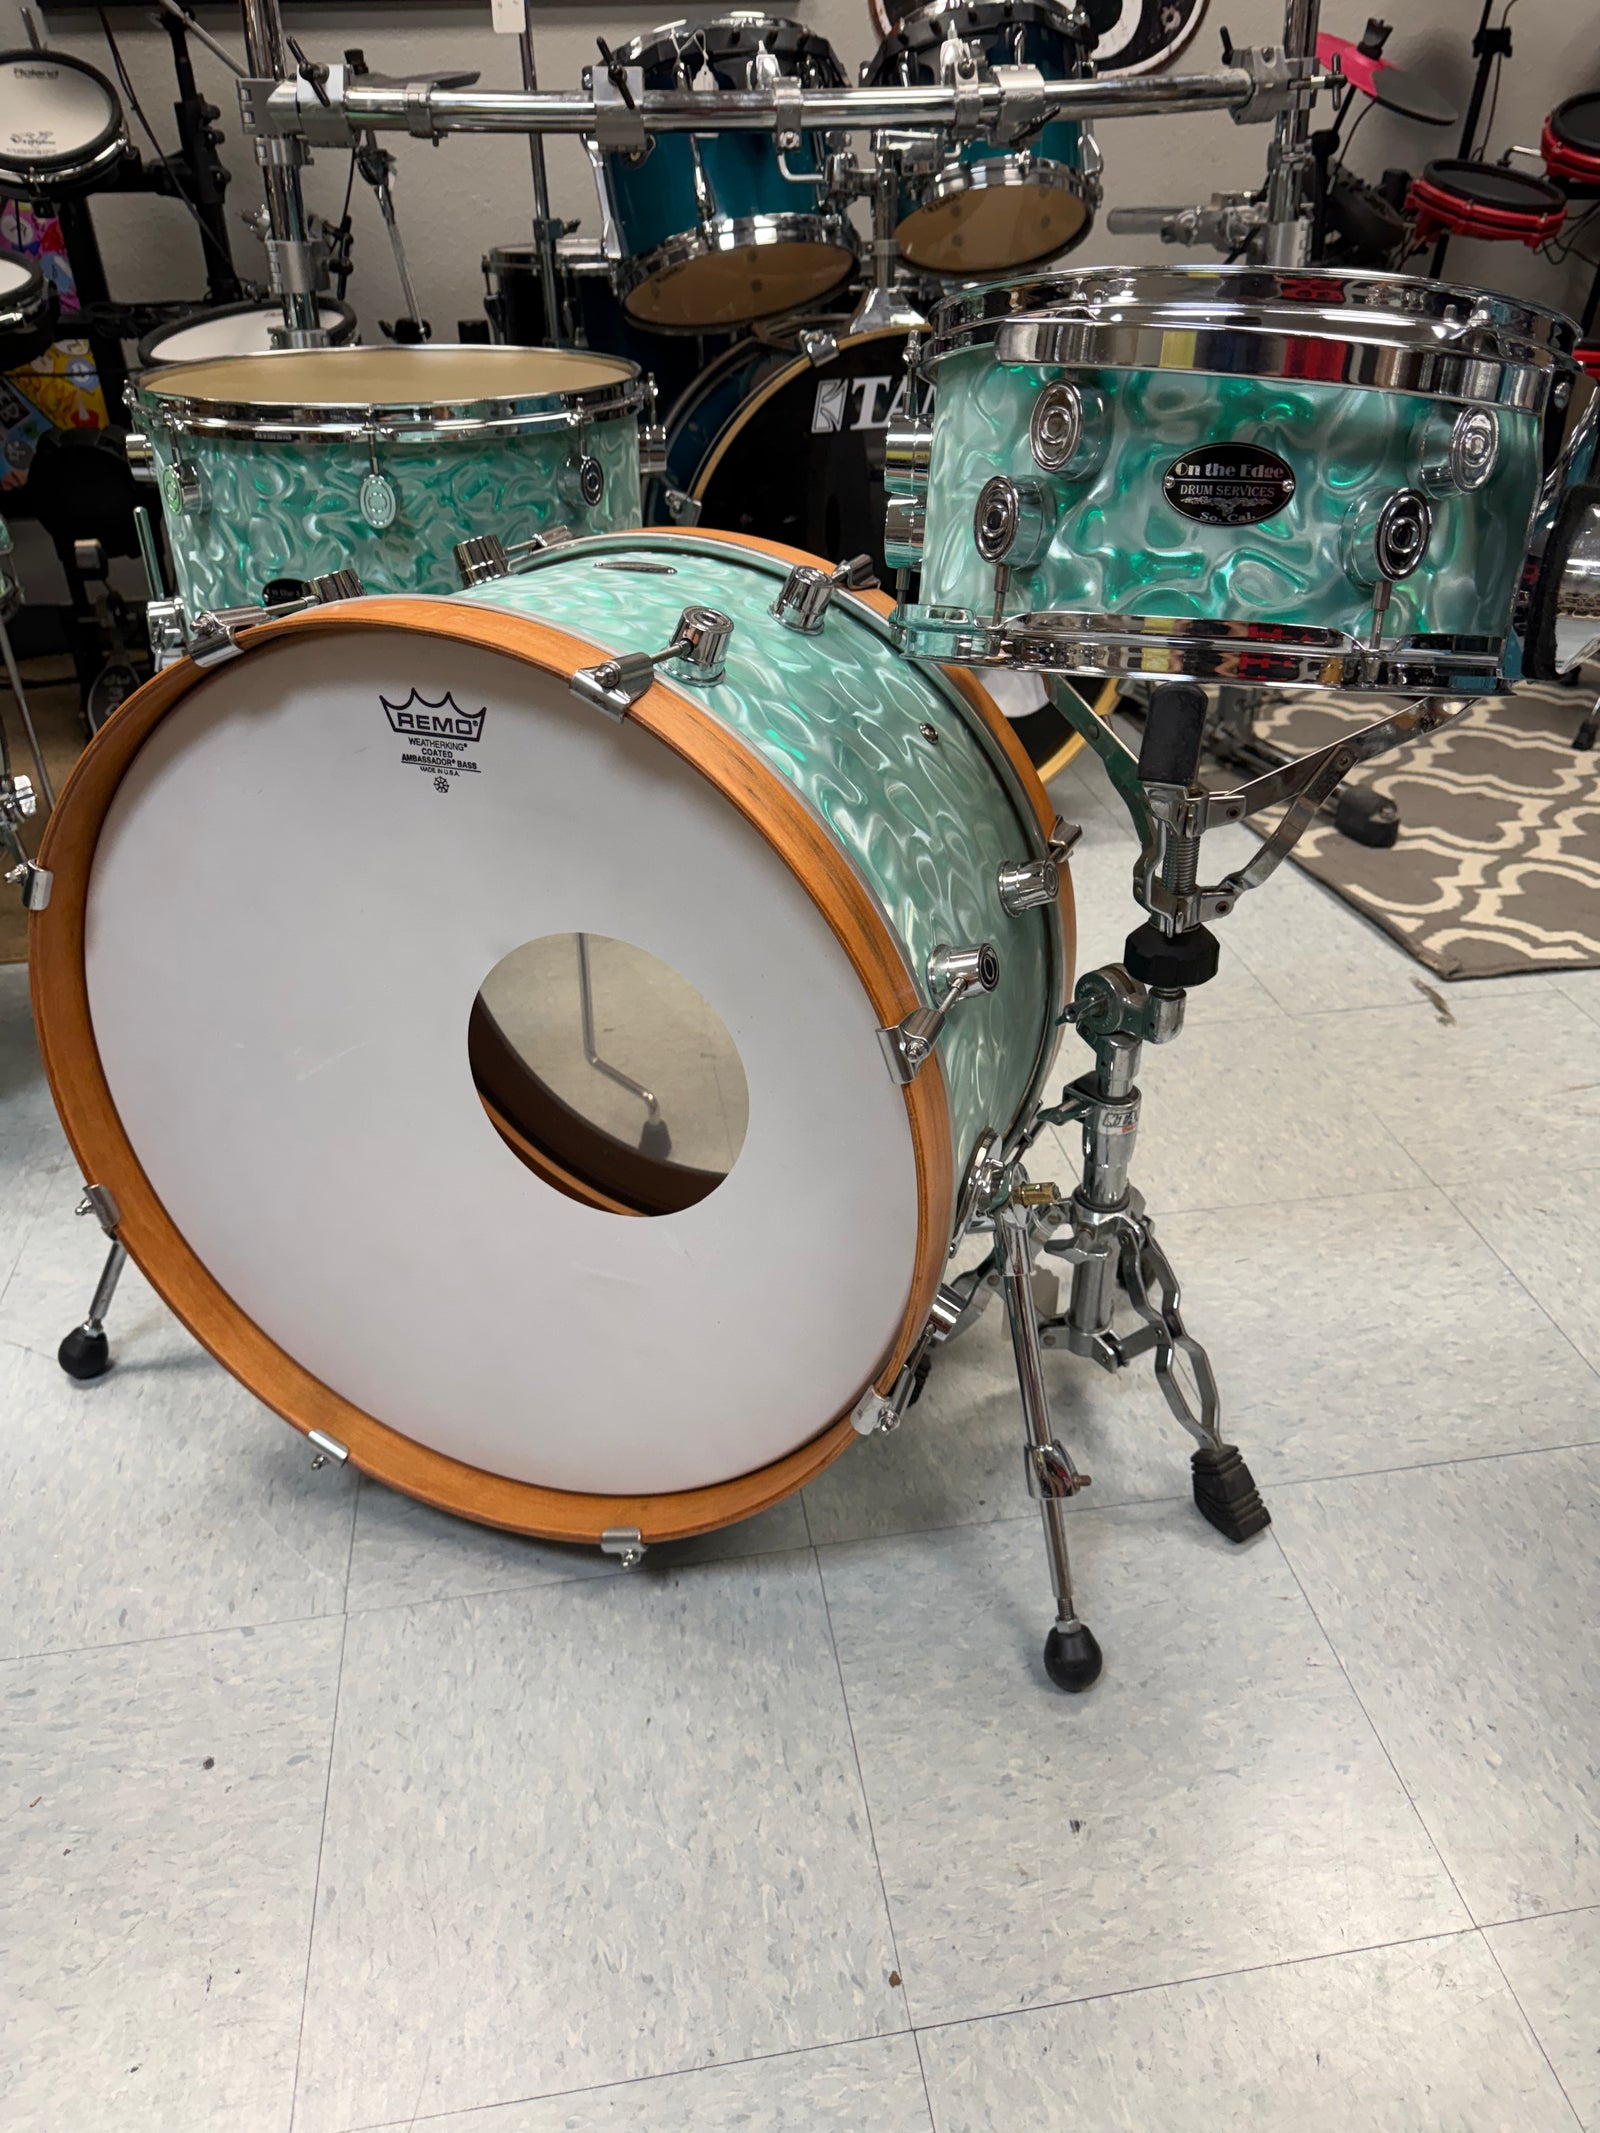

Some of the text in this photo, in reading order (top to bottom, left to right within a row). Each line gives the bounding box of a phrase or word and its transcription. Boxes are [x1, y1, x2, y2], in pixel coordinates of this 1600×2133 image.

[849, 375, 936, 431] TA
[1175, 462, 1284, 478] On the Edge
[1180, 484, 1275, 497] DRUM SERVICES
[397, 712, 473, 735] REMO
[422, 748, 453, 758] COATED
[457, 760, 477, 769] BASS
